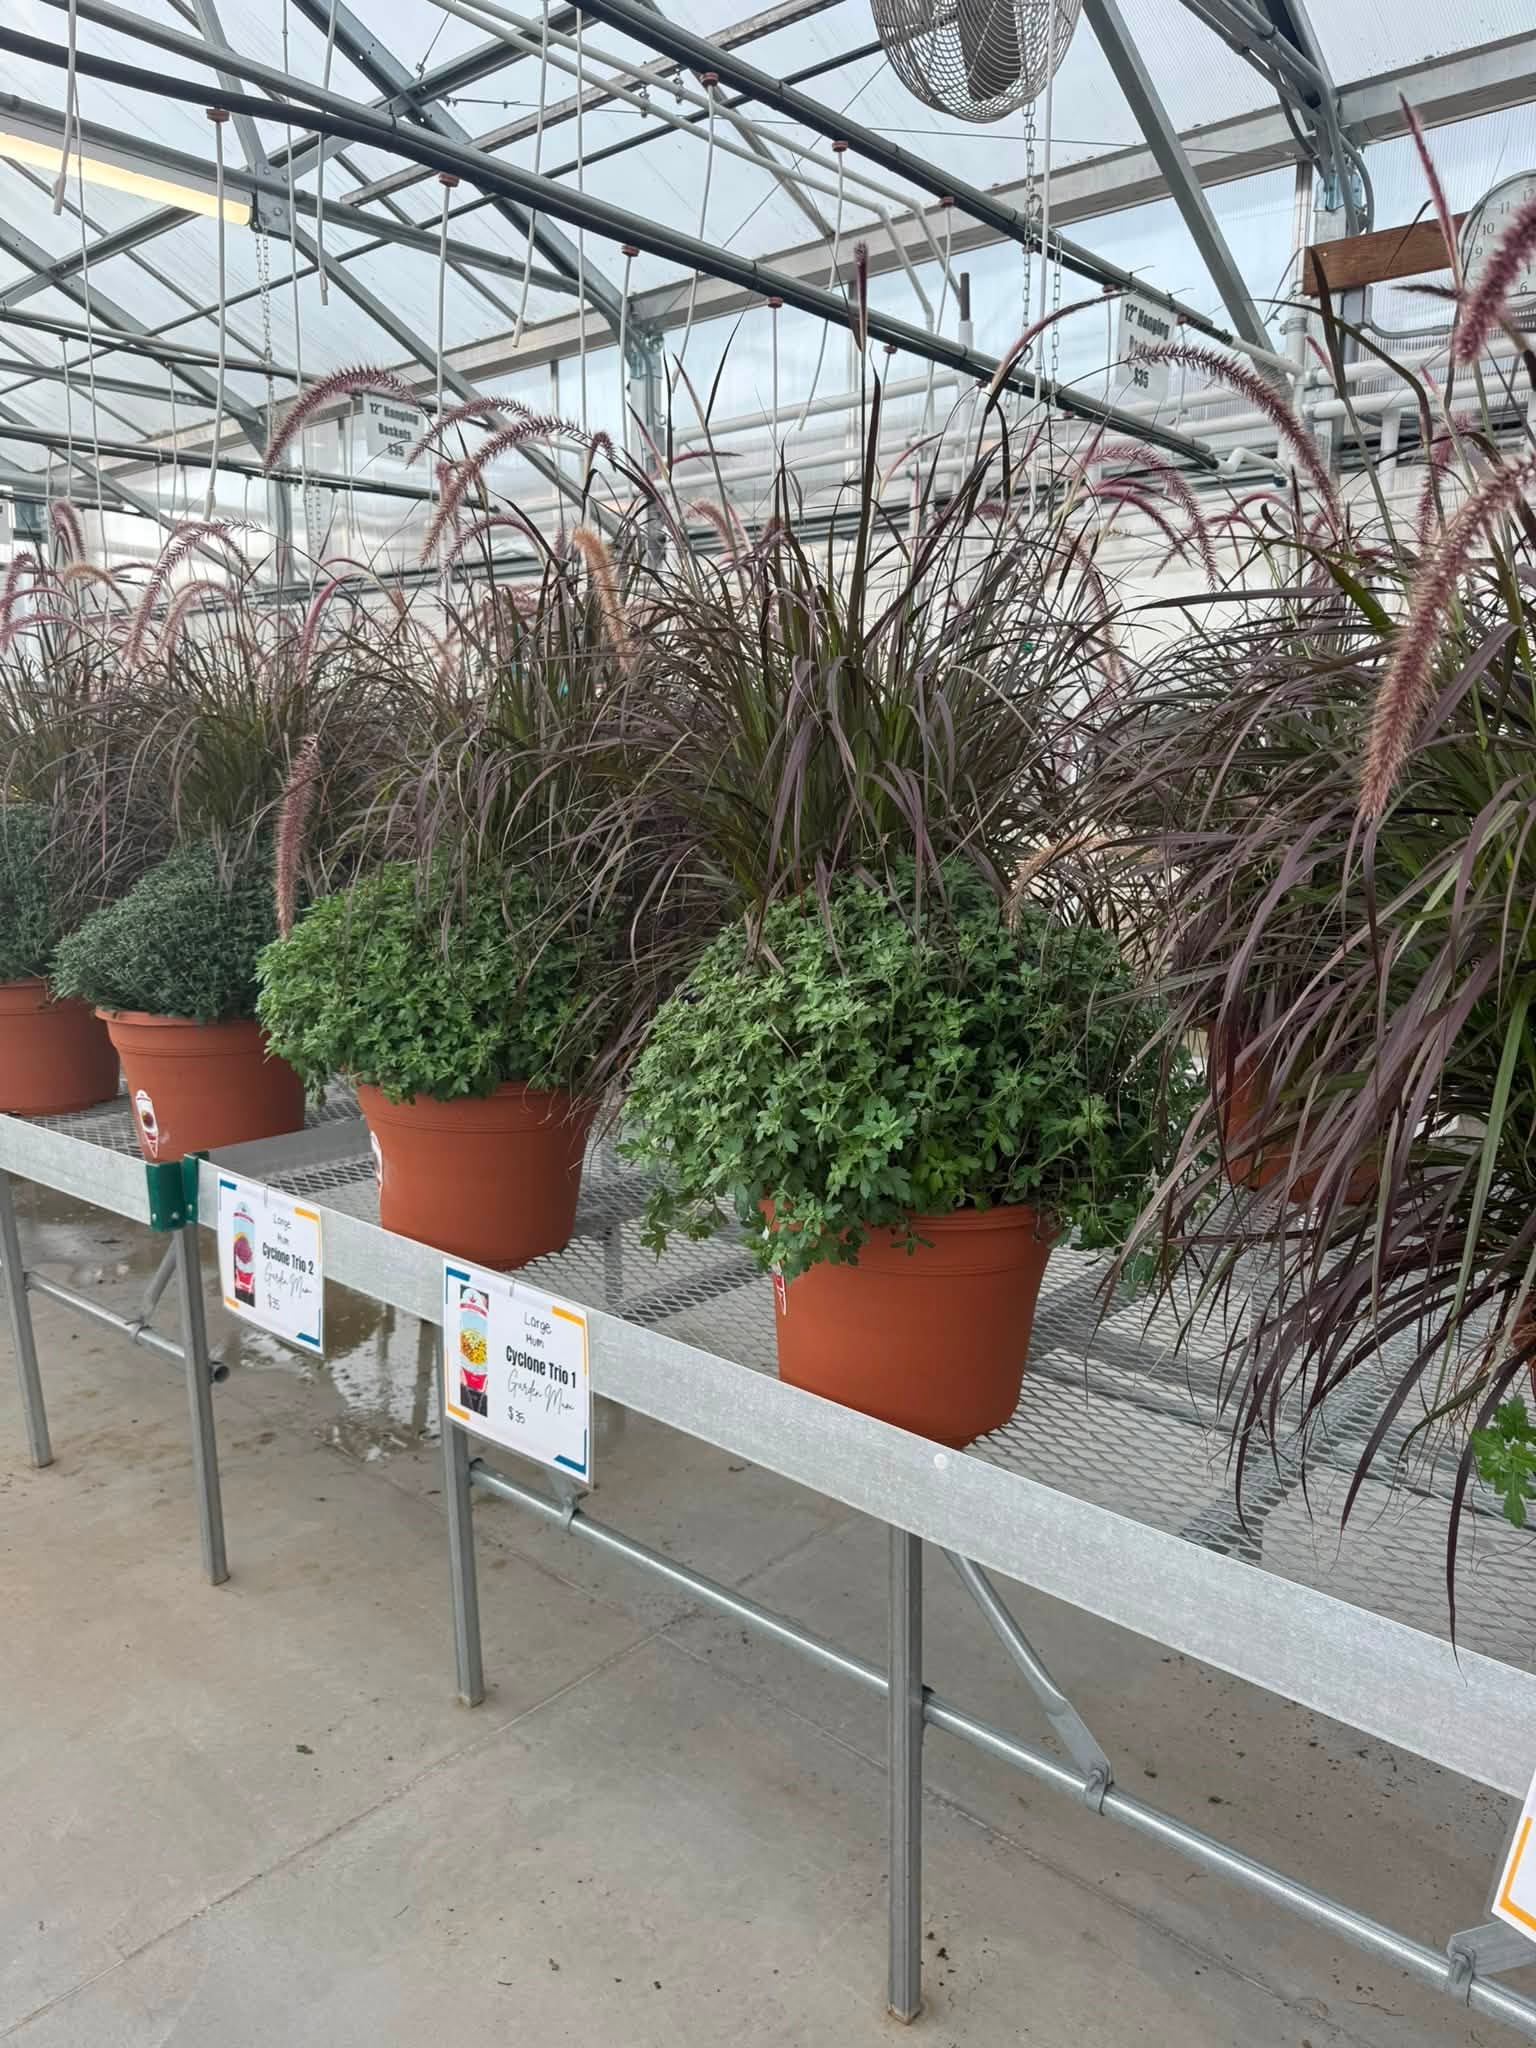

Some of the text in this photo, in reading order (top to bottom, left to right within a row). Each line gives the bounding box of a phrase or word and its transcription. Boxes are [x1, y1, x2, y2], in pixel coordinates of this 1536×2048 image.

[1482, 222, 1495, 236] 10
[1475, 247, 1483, 258] 9
[1520, 281, 1528, 294] 6
[273, 1212, 292, 1231] Large
[262, 1242, 315, 1276] Cyclone Trio 2
[524, 1312, 552, 1335] Large
[506, 1345, 576, 1388] Cyclone Trio 1
[508, 1405, 526, 1424] $35
